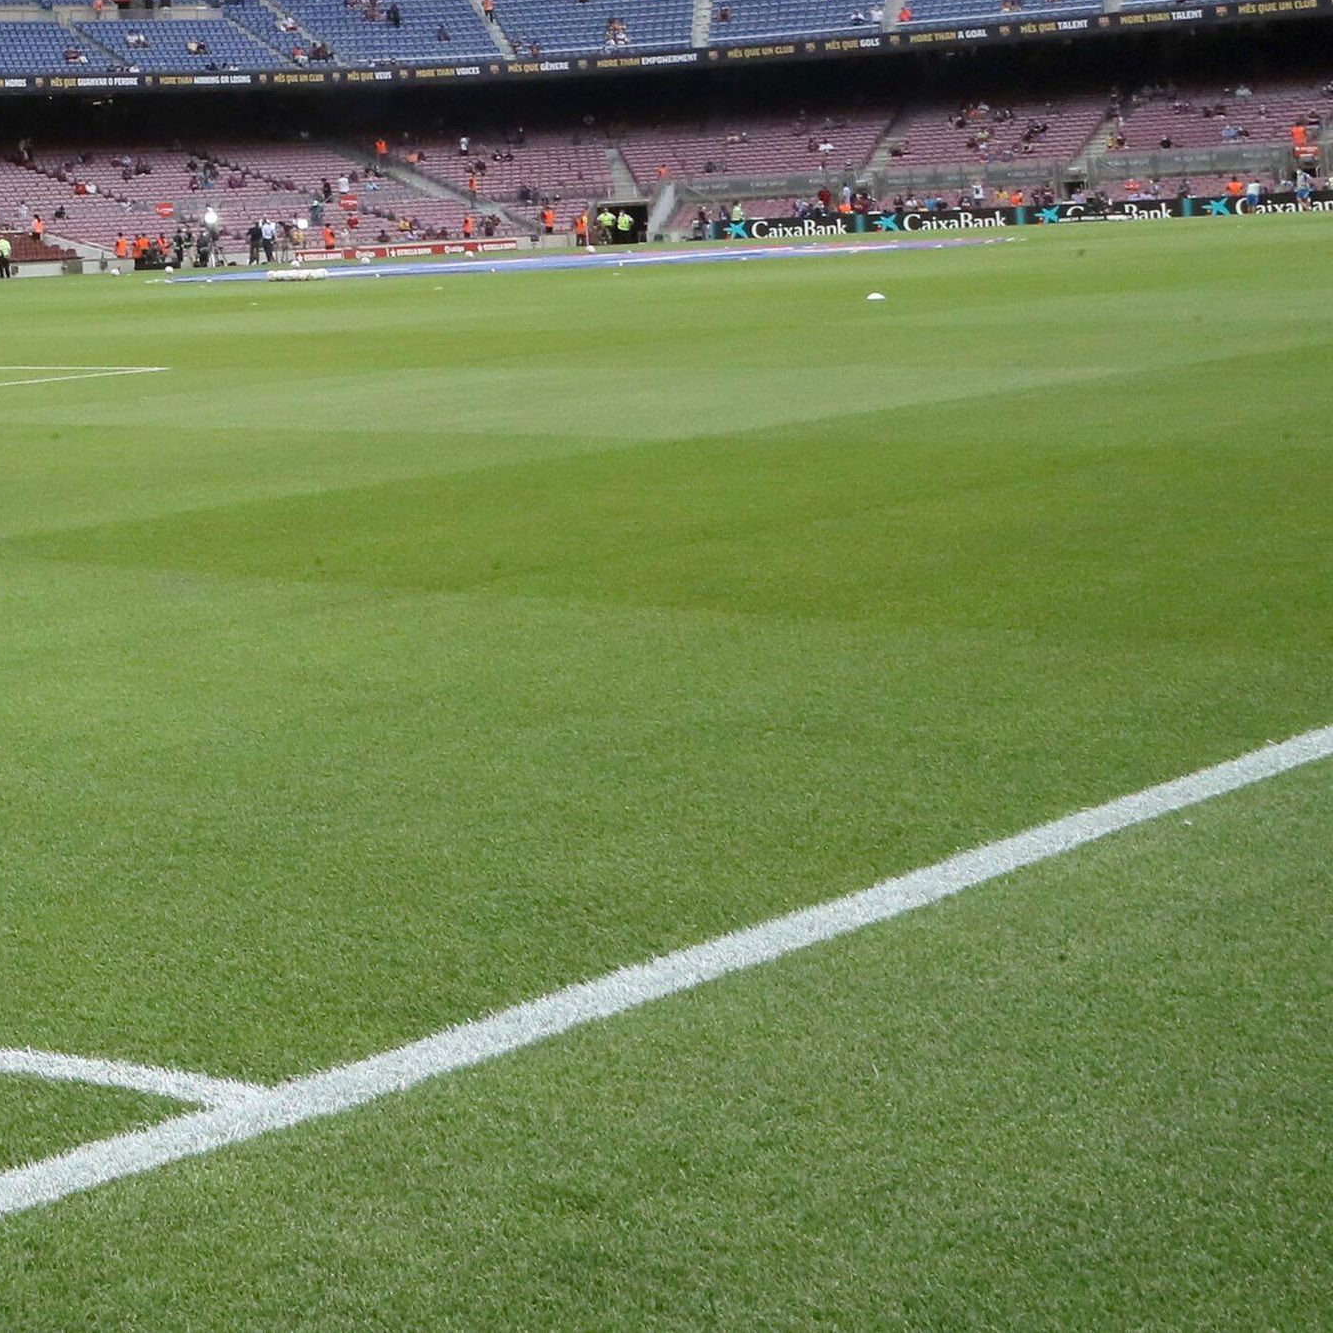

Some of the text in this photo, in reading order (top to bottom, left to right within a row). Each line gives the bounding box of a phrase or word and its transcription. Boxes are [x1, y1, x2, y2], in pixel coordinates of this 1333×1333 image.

[1171, 9, 1203, 21] TALENT
[1057, 19, 1088, 30] TALENT
[751, 218, 847, 239] CaixaBank
[903, 210, 1006, 232] CaixaBank
